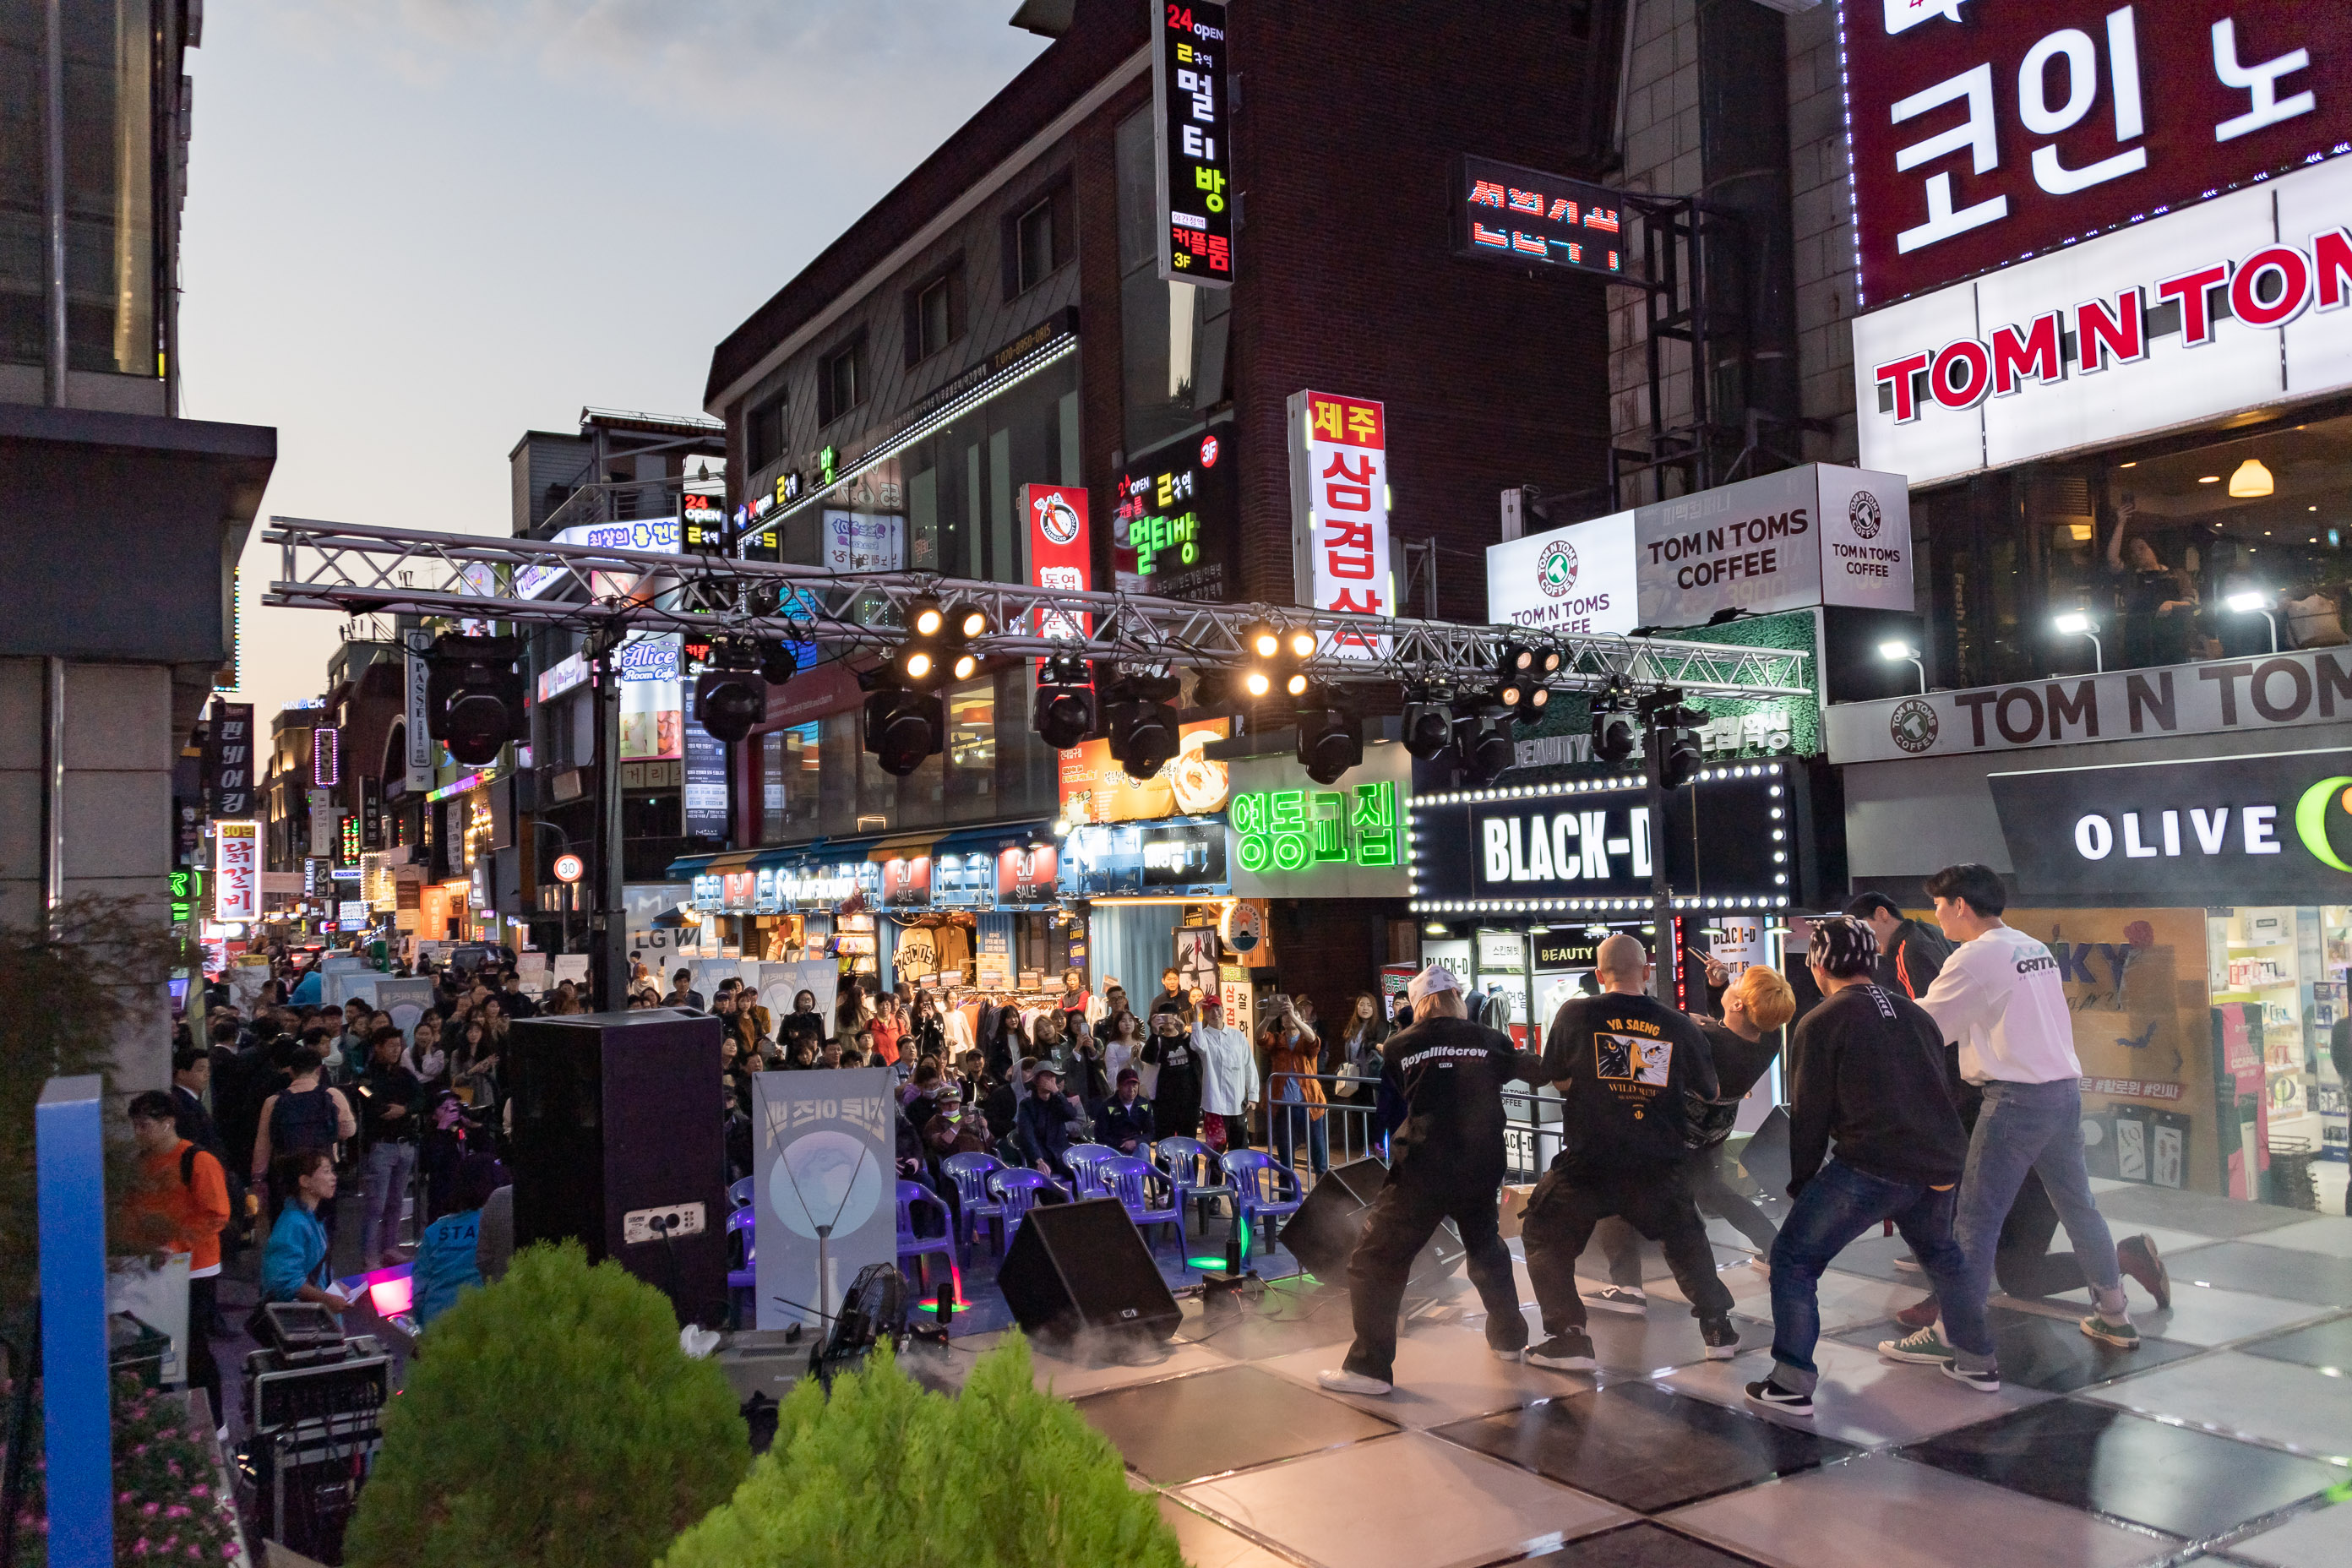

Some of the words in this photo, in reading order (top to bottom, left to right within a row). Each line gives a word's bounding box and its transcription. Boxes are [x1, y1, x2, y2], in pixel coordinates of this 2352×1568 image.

[1168, 4, 1193, 32] 24
[1173, 227, 1229, 271] 커플룸
[1174, 253, 1190, 268] 3F
[1874, 308, 2065, 426] TOM
[2073, 286, 2151, 376] N
[1315, 401, 1376, 443] 제주
[1202, 441, 1217, 463] 3F
[1119, 474, 1131, 497] 24
[1130, 476, 1150, 494] OPEN
[685, 494, 708, 509] 24
[685, 509, 721, 523] OPEN
[589, 529, 629, 547] 최상의
[1647, 532, 1701, 564] TOM
[1707, 527, 1724, 553] N
[1729, 509, 1809, 547] TOMS
[1852, 520, 1879, 538] COFFEE
[1130, 512, 1200, 575] 멀티방
[1549, 542, 1558, 553] N
[1832, 543, 1858, 558] TOM
[1859, 547, 1867, 559] N
[1869, 547, 1900, 563] TOMS
[1538, 551, 1552, 575] TOM
[1558, 542, 1577, 568] TOMS
[1677, 548, 1778, 590] COFFEE
[1846, 562, 1889, 578] COFFEE
[1541, 573, 1576, 596] COFFEE
[1511, 607, 1545, 626] TOM
[1549, 603, 1559, 621] N
[1562, 593, 1610, 618] TOMS
[622, 643, 677, 667] Alice
[625, 669, 653, 680] Room
[654, 667, 677, 682] Cafe
[1906, 701, 1914, 710] N
[1915, 702, 1936, 727] TOMS
[1954, 679, 2099, 747] TOM
[2126, 671, 2177, 734] N
[1892, 706, 1906, 728] TOM
[1896, 732, 1936, 751] COFFEE
[223, 826, 254, 837] 30년
[2074, 805, 2281, 860] OLIVE
[1483, 807, 1653, 883] BLACK-D
[561, 863, 575, 874] 30
[896, 861, 912, 884] 50
[1015, 851, 1036, 877] 50
[222, 841, 255, 910] 닭갈비
[734, 874, 744, 890] 50
[732, 896, 744, 906] SALE
[896, 889, 913, 902] SALE
[1015, 884, 1037, 899] SALE
[1244, 906, 1260, 936] COMPANY
[635, 930, 666, 949] LG
[1542, 946, 1593, 961] BEAUTY
[1607, 1019, 1623, 1031] YA
[1626, 1019, 1661, 1037] SAENG
[1609, 1083, 1636, 1093] WILD
[440, 1224, 476, 1241] STA
